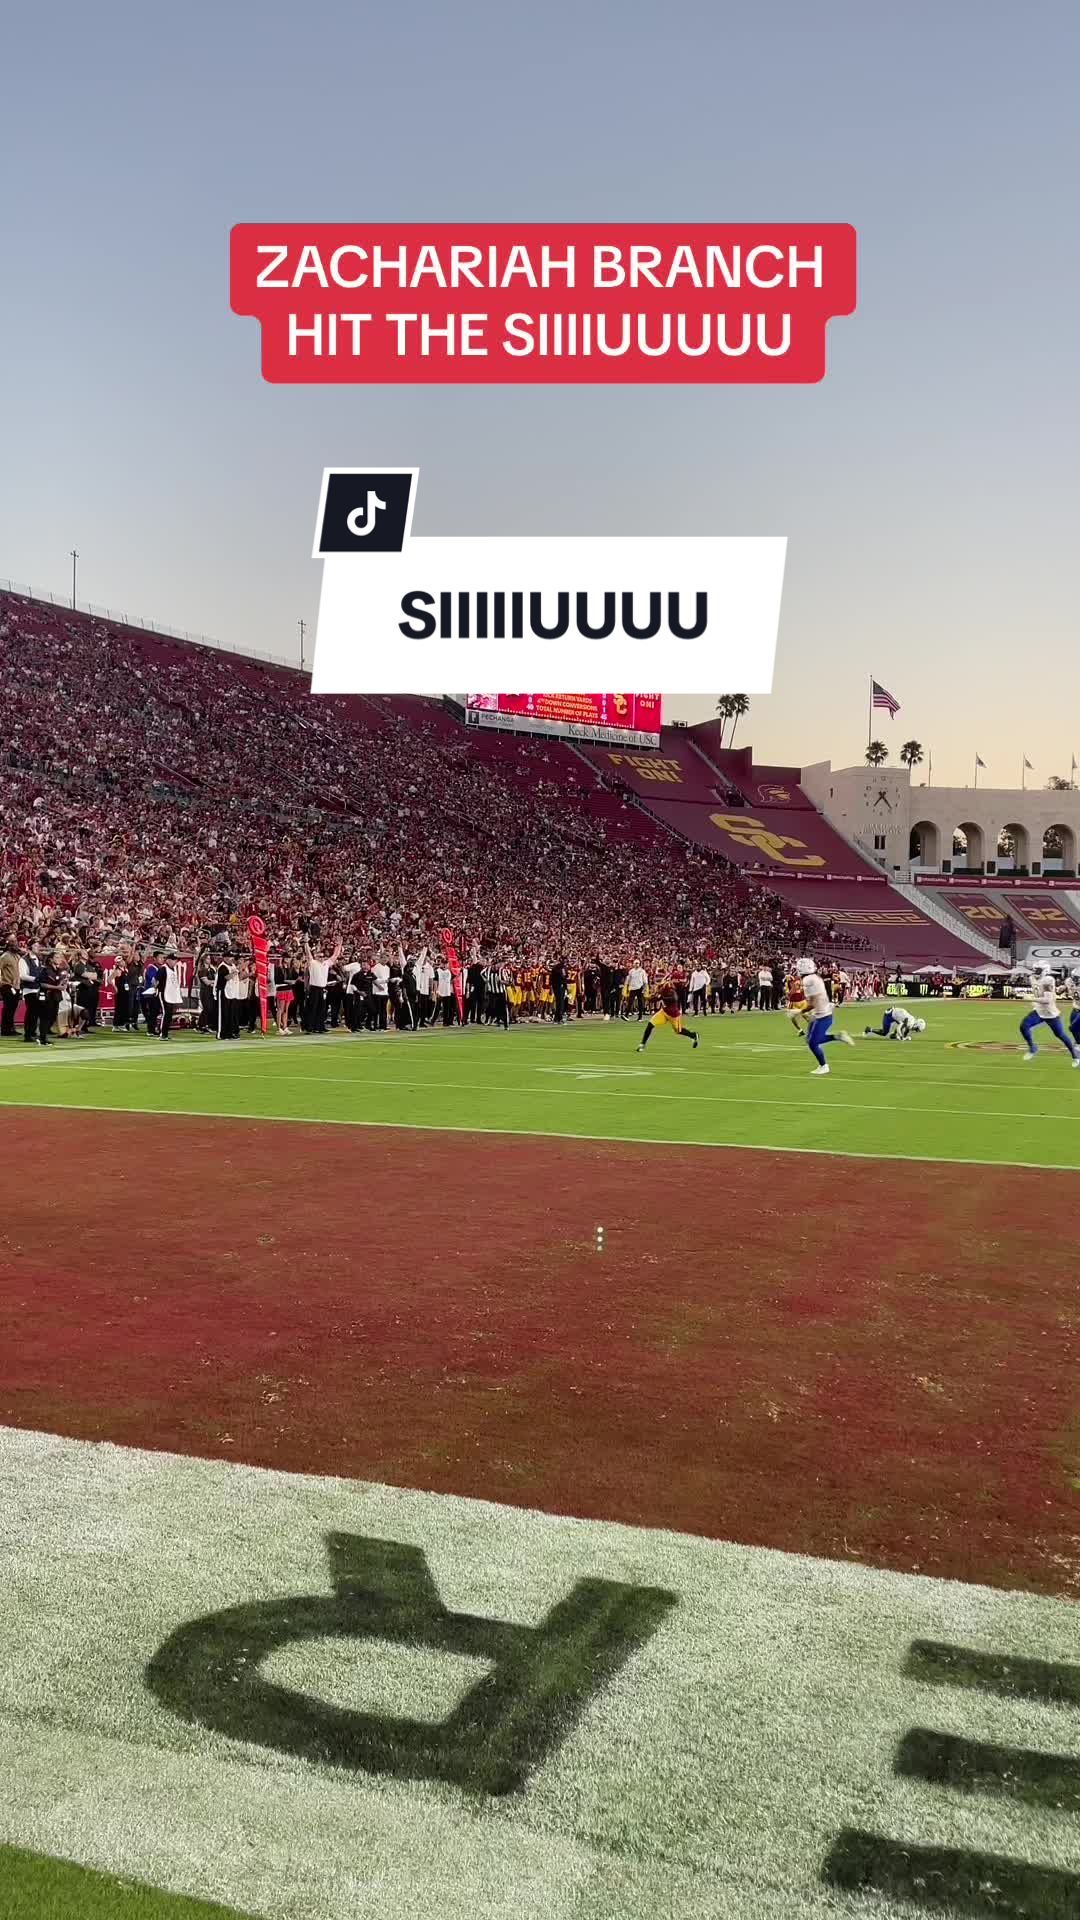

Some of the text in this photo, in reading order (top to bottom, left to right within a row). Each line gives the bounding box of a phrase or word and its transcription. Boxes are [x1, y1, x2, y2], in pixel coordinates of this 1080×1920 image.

[568, 724, 589, 738] Keck
[591, 728, 627, 742] Medicine
[628, 733, 637, 742] of
[640, 733, 657, 746] USC
[607, 753, 683, 771] FIGHT
[636, 768, 684, 783] ON!
[958, 905, 1008, 919] 20
[1020, 907, 1069, 921] 32
